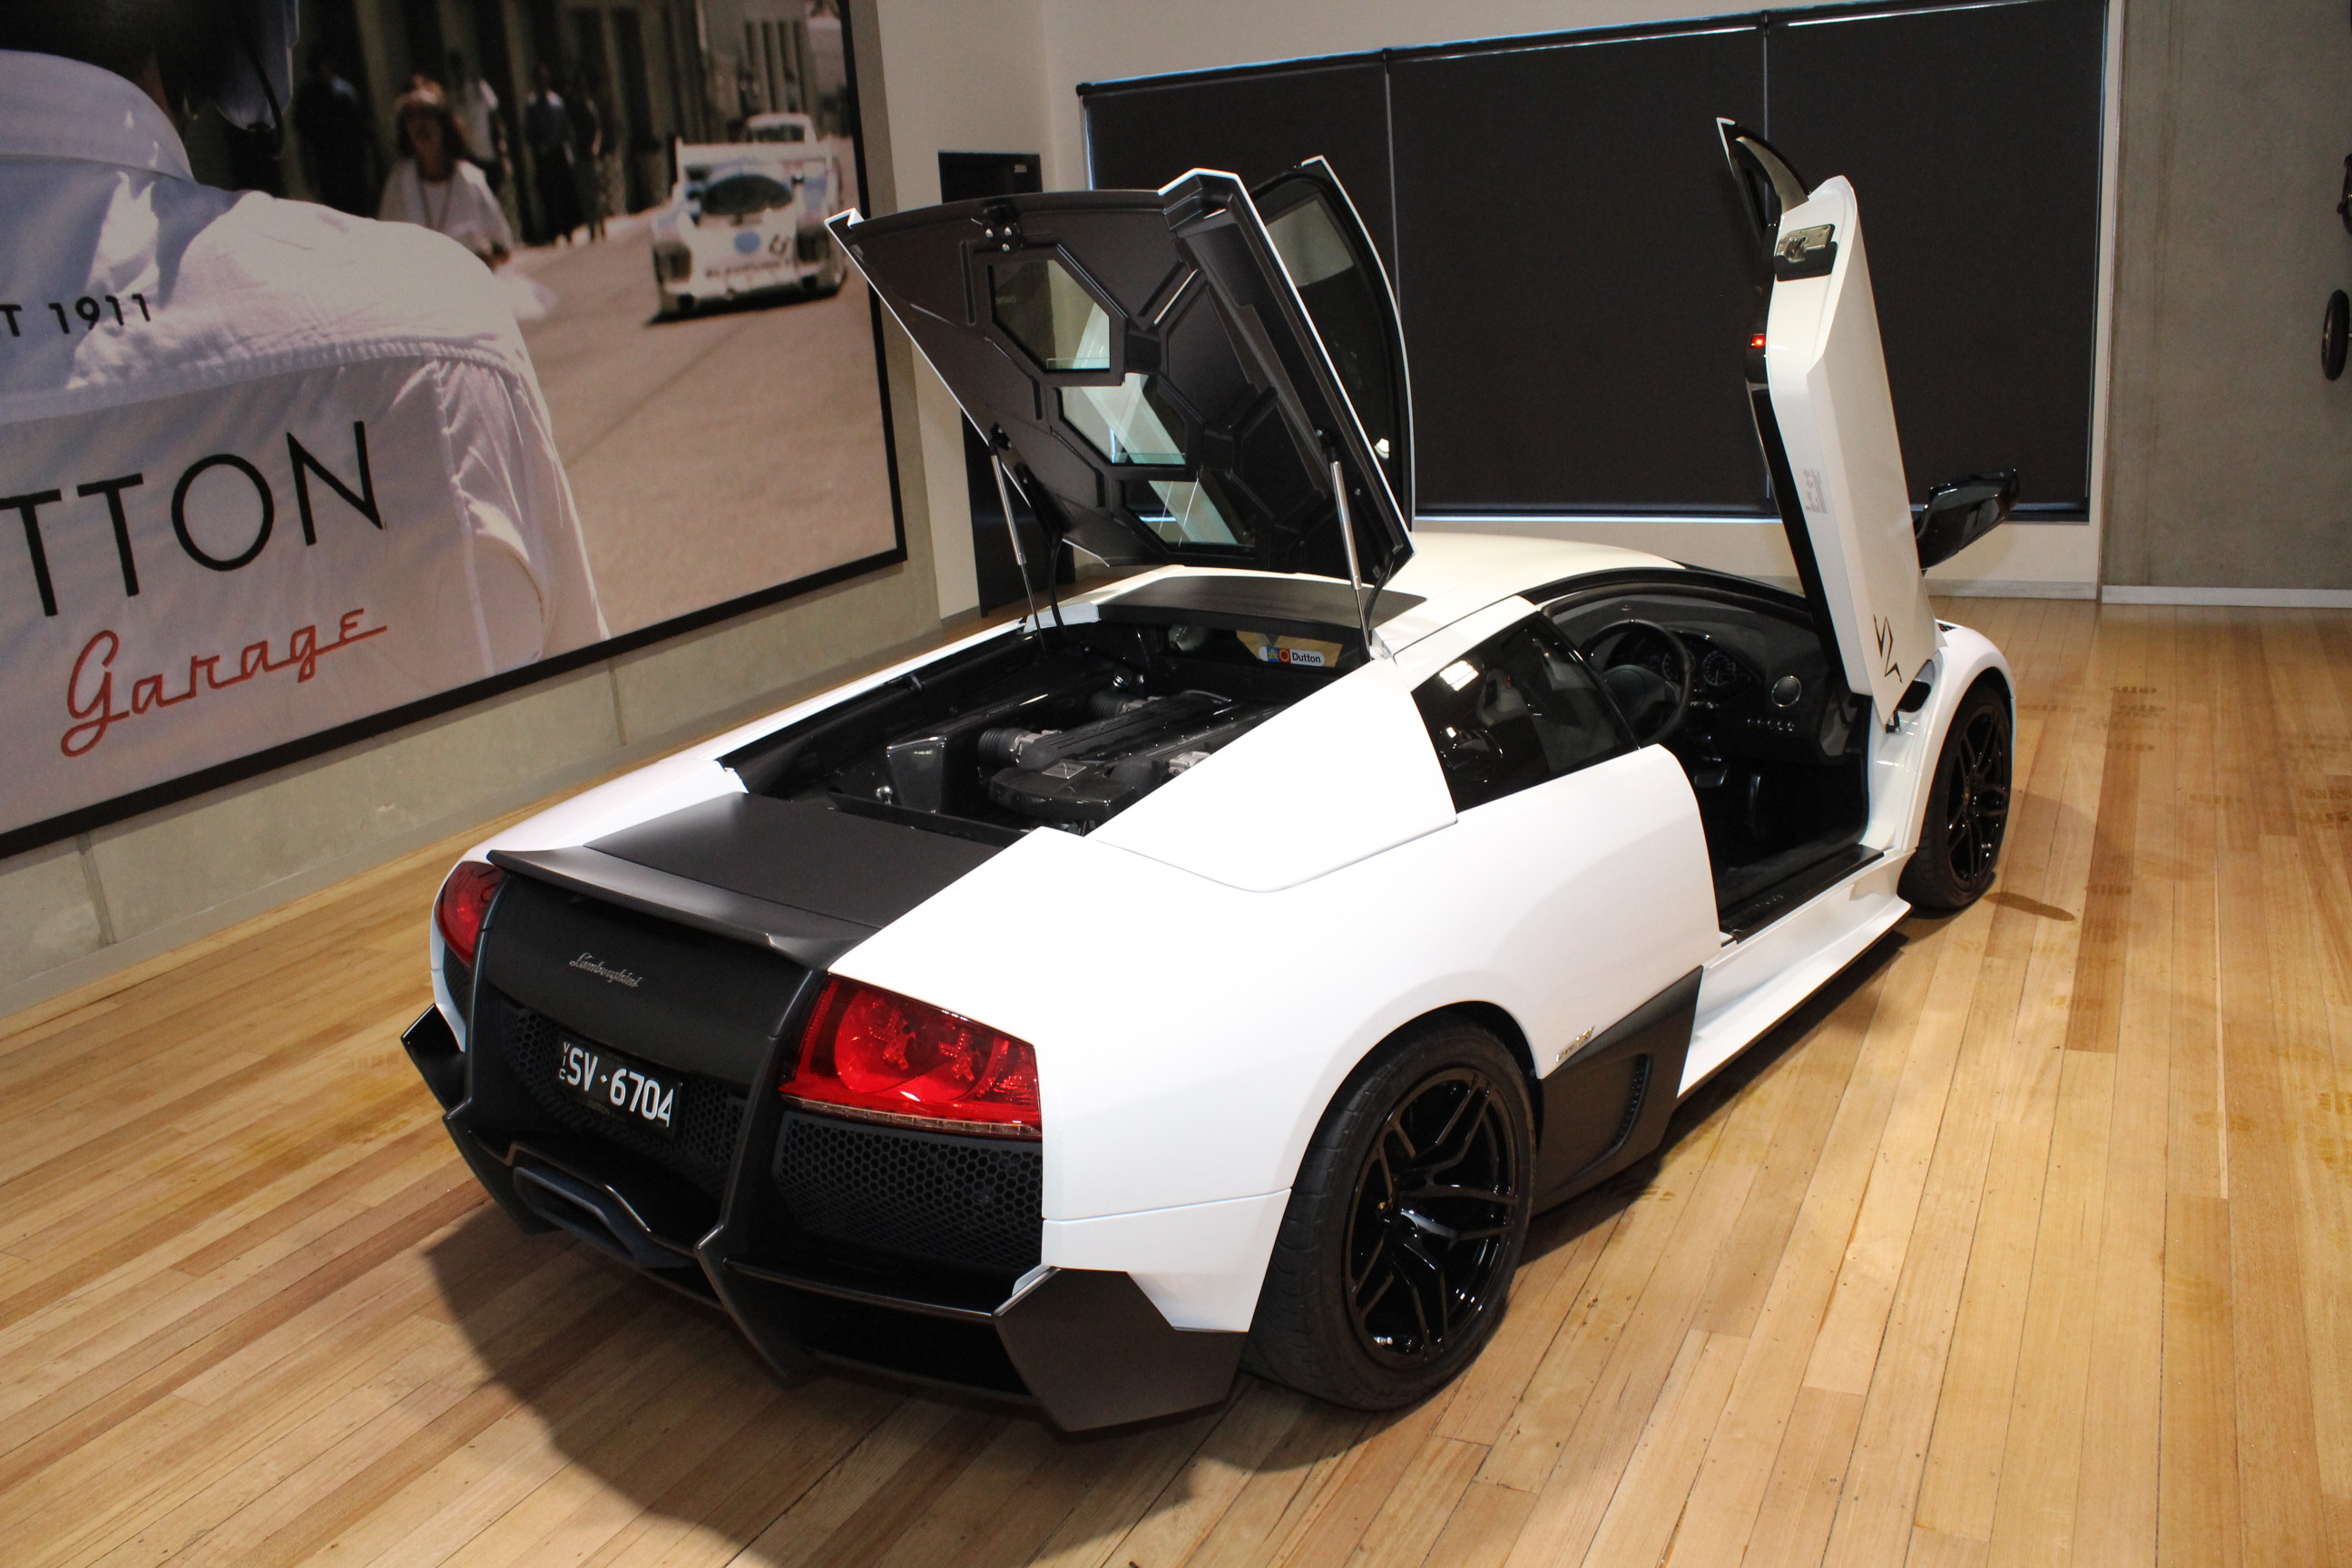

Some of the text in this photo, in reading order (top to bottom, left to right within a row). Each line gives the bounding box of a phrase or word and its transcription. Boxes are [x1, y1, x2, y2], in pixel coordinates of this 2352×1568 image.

[48, 292, 152, 334] 1911
[0, 420, 385, 617] TTON
[1291, 652, 1321, 664] Dutton
[60, 608, 387, 758] Garage
[569, 952, 644, 988] Lamborghini
